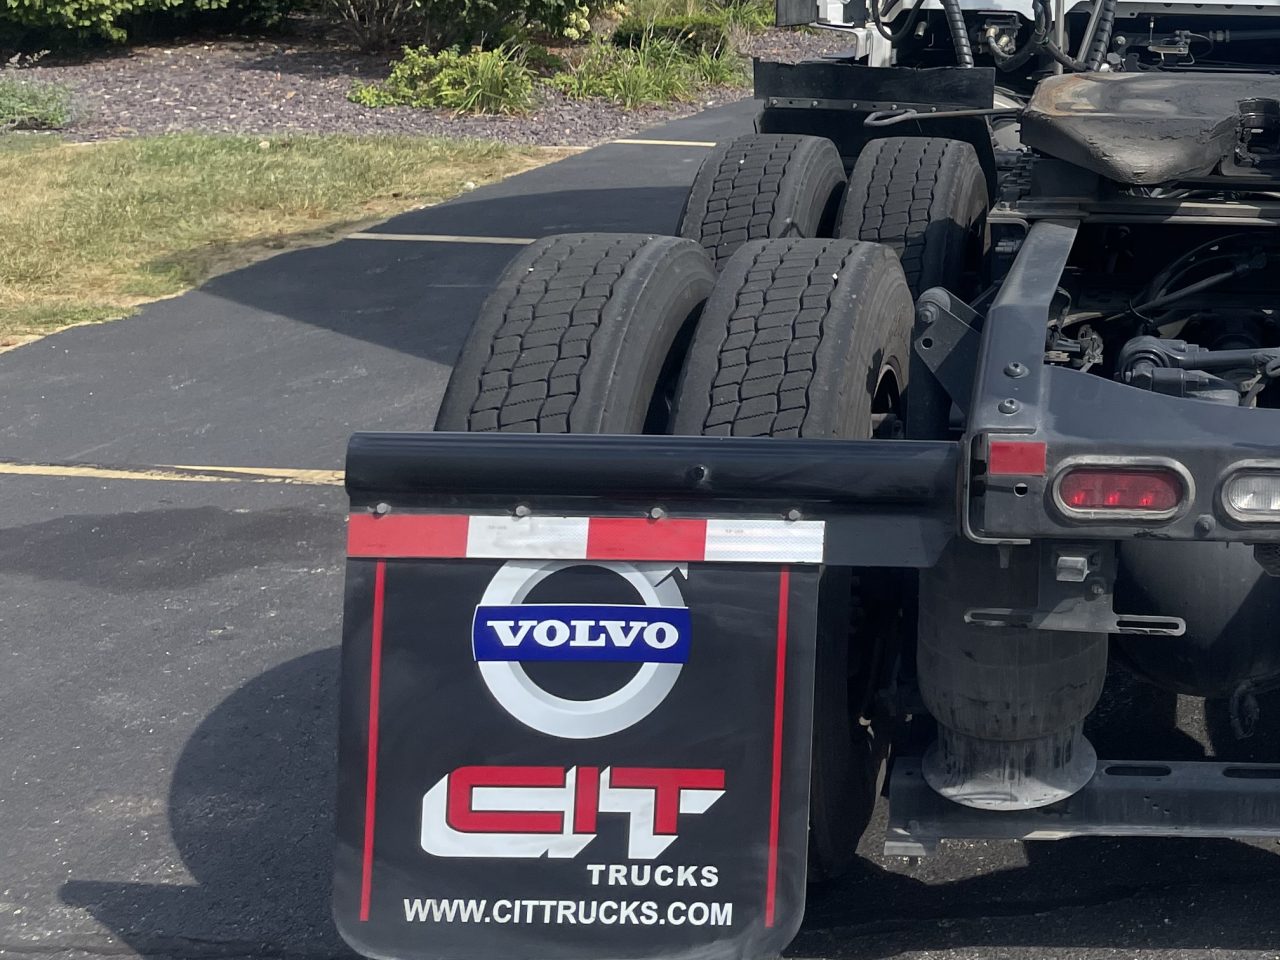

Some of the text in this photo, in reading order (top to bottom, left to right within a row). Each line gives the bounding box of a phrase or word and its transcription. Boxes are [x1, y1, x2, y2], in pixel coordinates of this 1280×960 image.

[486, 619, 679, 649] VOLVO
[420, 765, 727, 860] CIT
[586, 864, 719, 888] TRUCKS
[403, 898, 733, 927] WWW.CITTRUCKS.COM
